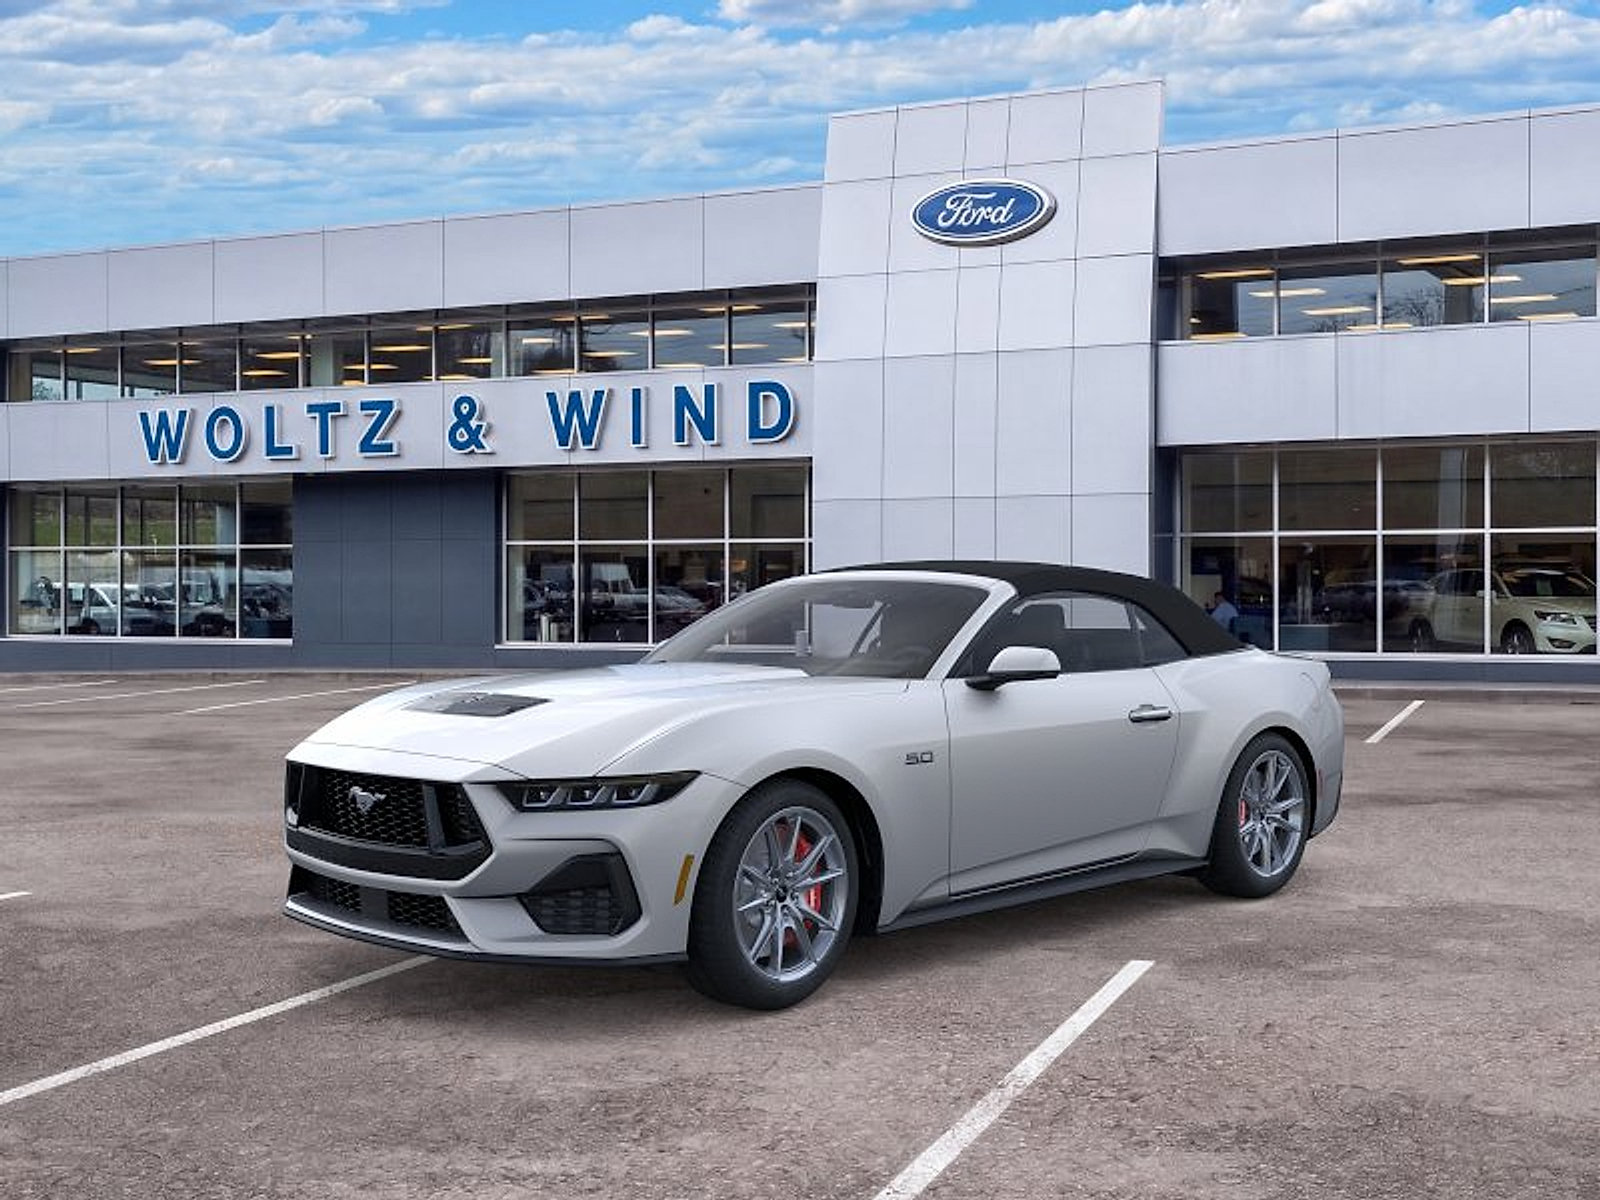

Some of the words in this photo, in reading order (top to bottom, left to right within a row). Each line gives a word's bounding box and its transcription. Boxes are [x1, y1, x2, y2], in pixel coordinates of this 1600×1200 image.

[937, 192, 1016, 228] Ford
[139, 399, 400, 464] WOLTZ
[447, 395, 490, 454] &
[545, 380, 796, 450] WIND
